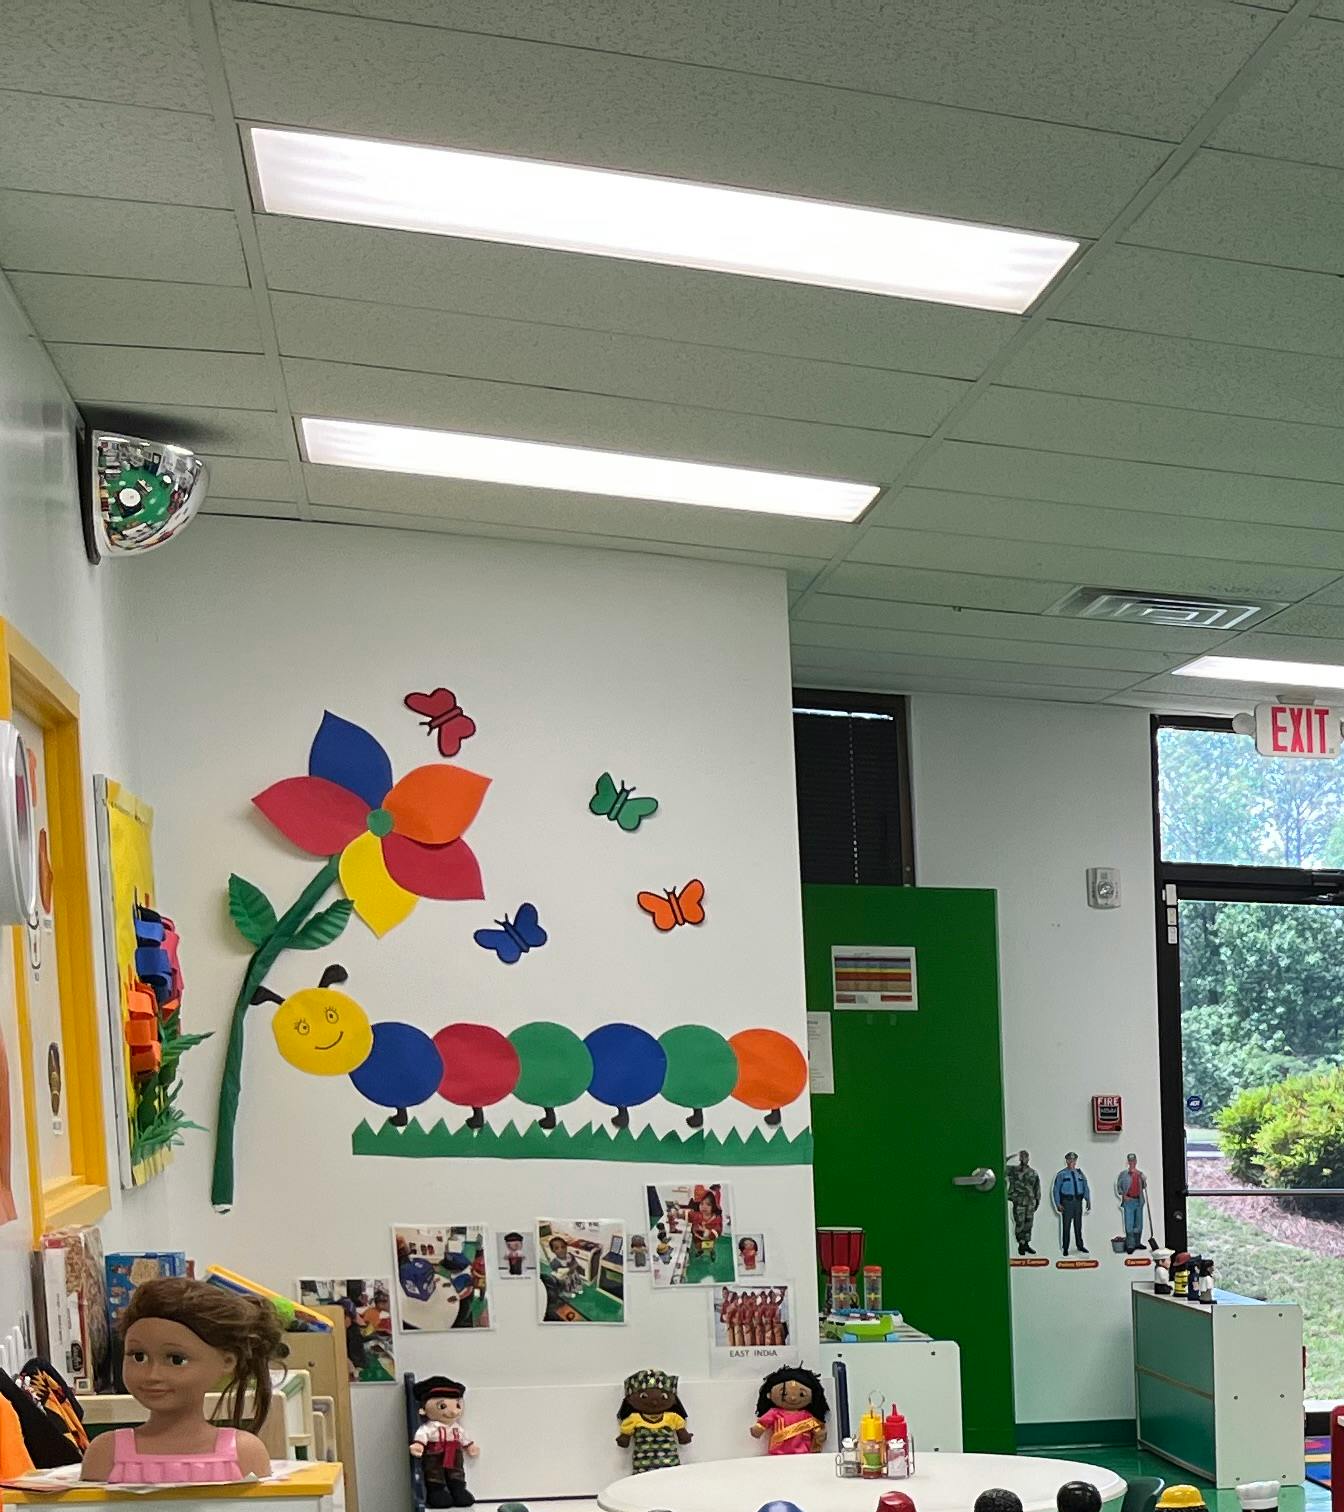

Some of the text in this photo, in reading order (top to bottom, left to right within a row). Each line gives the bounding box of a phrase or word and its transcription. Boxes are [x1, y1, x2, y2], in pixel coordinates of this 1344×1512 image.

[1271, 706, 1330, 753] EXIT
[1098, 1097, 1119, 1107] FIRE
[730, 1349, 777, 1357] EAST INDIA
